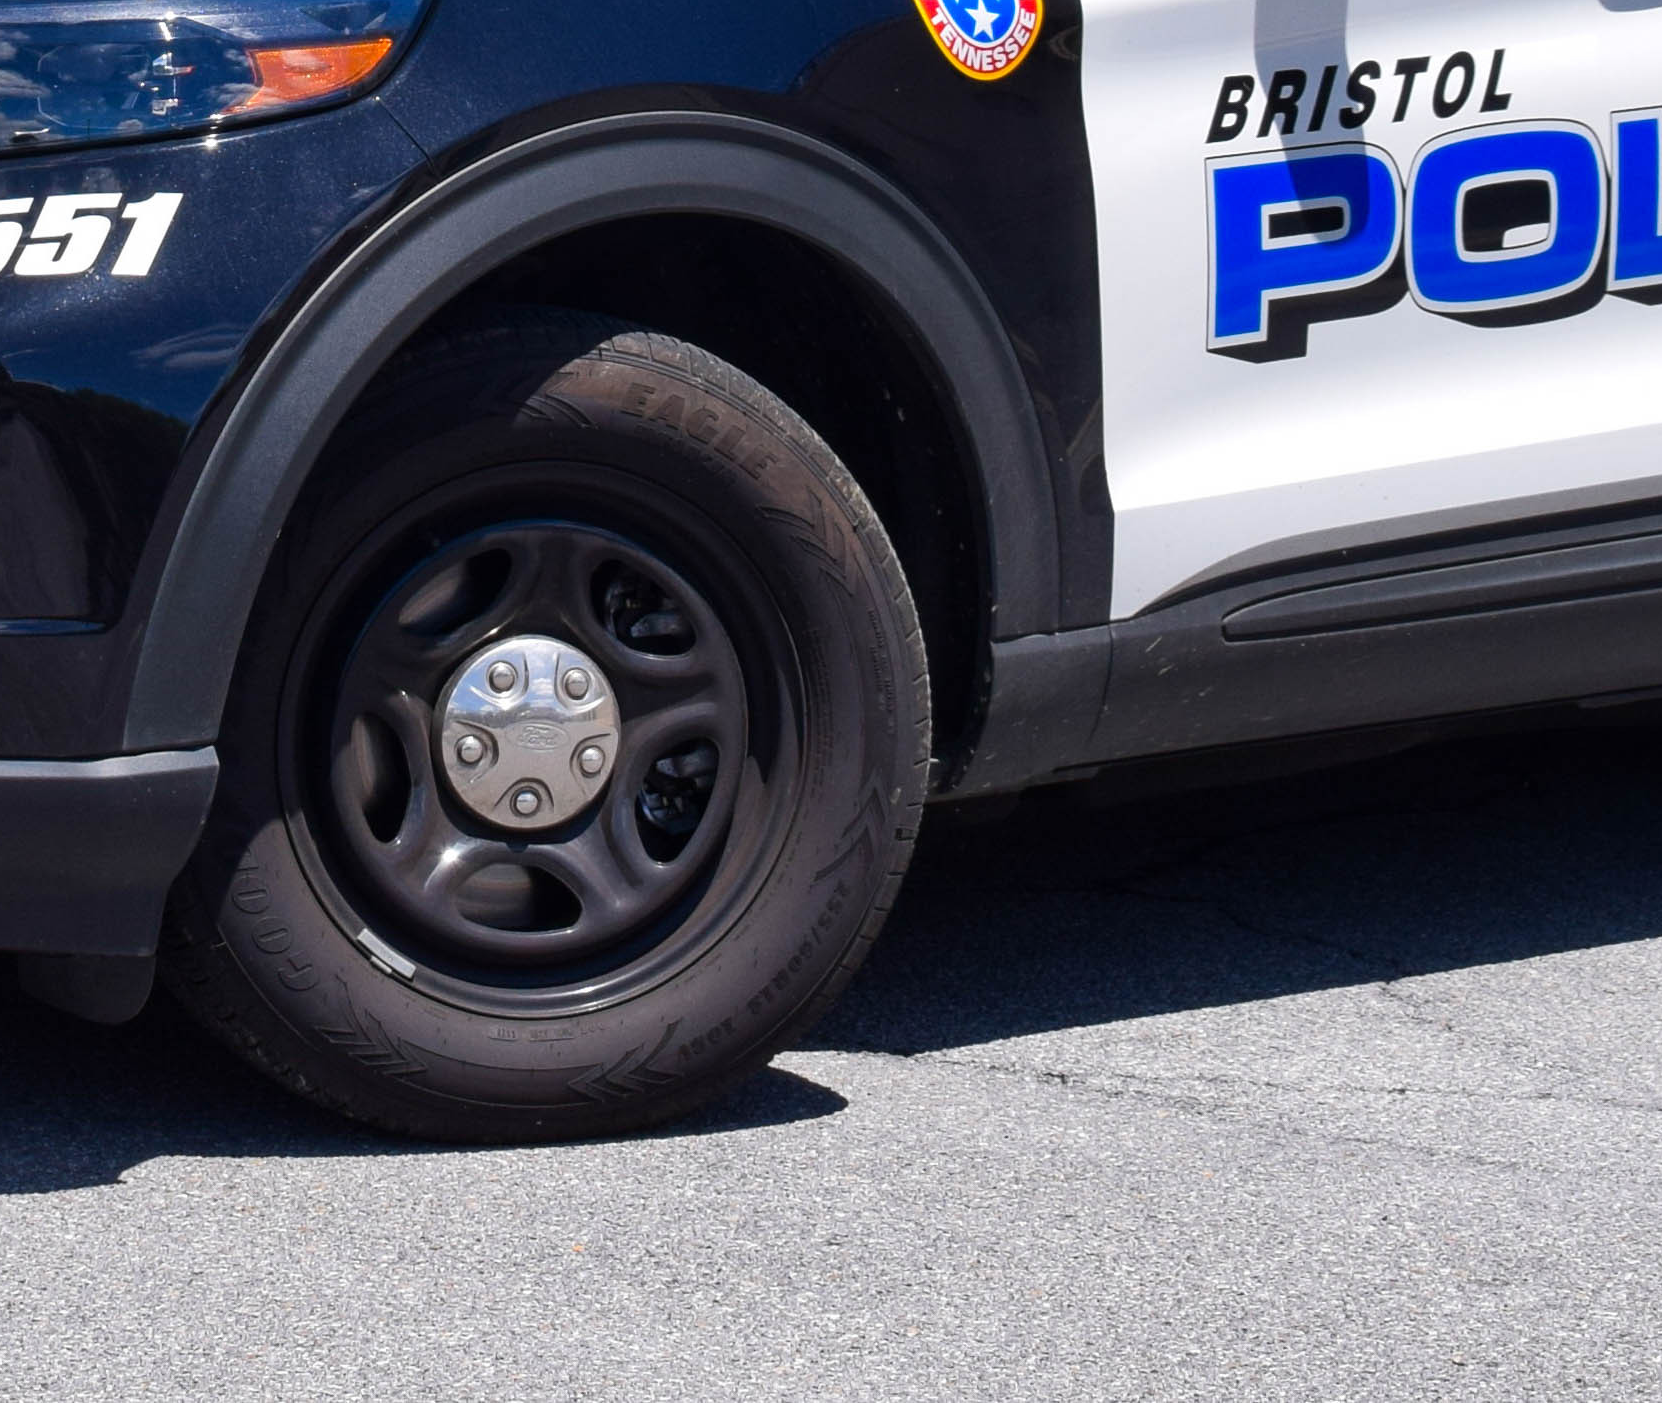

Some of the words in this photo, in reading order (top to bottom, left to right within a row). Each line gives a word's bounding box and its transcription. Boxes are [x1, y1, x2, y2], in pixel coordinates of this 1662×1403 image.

[930, 6, 1036, 72] TENNESSEE
[1205, 48, 1515, 145] BRISTOL
[620, 382, 780, 480] EAGLE
